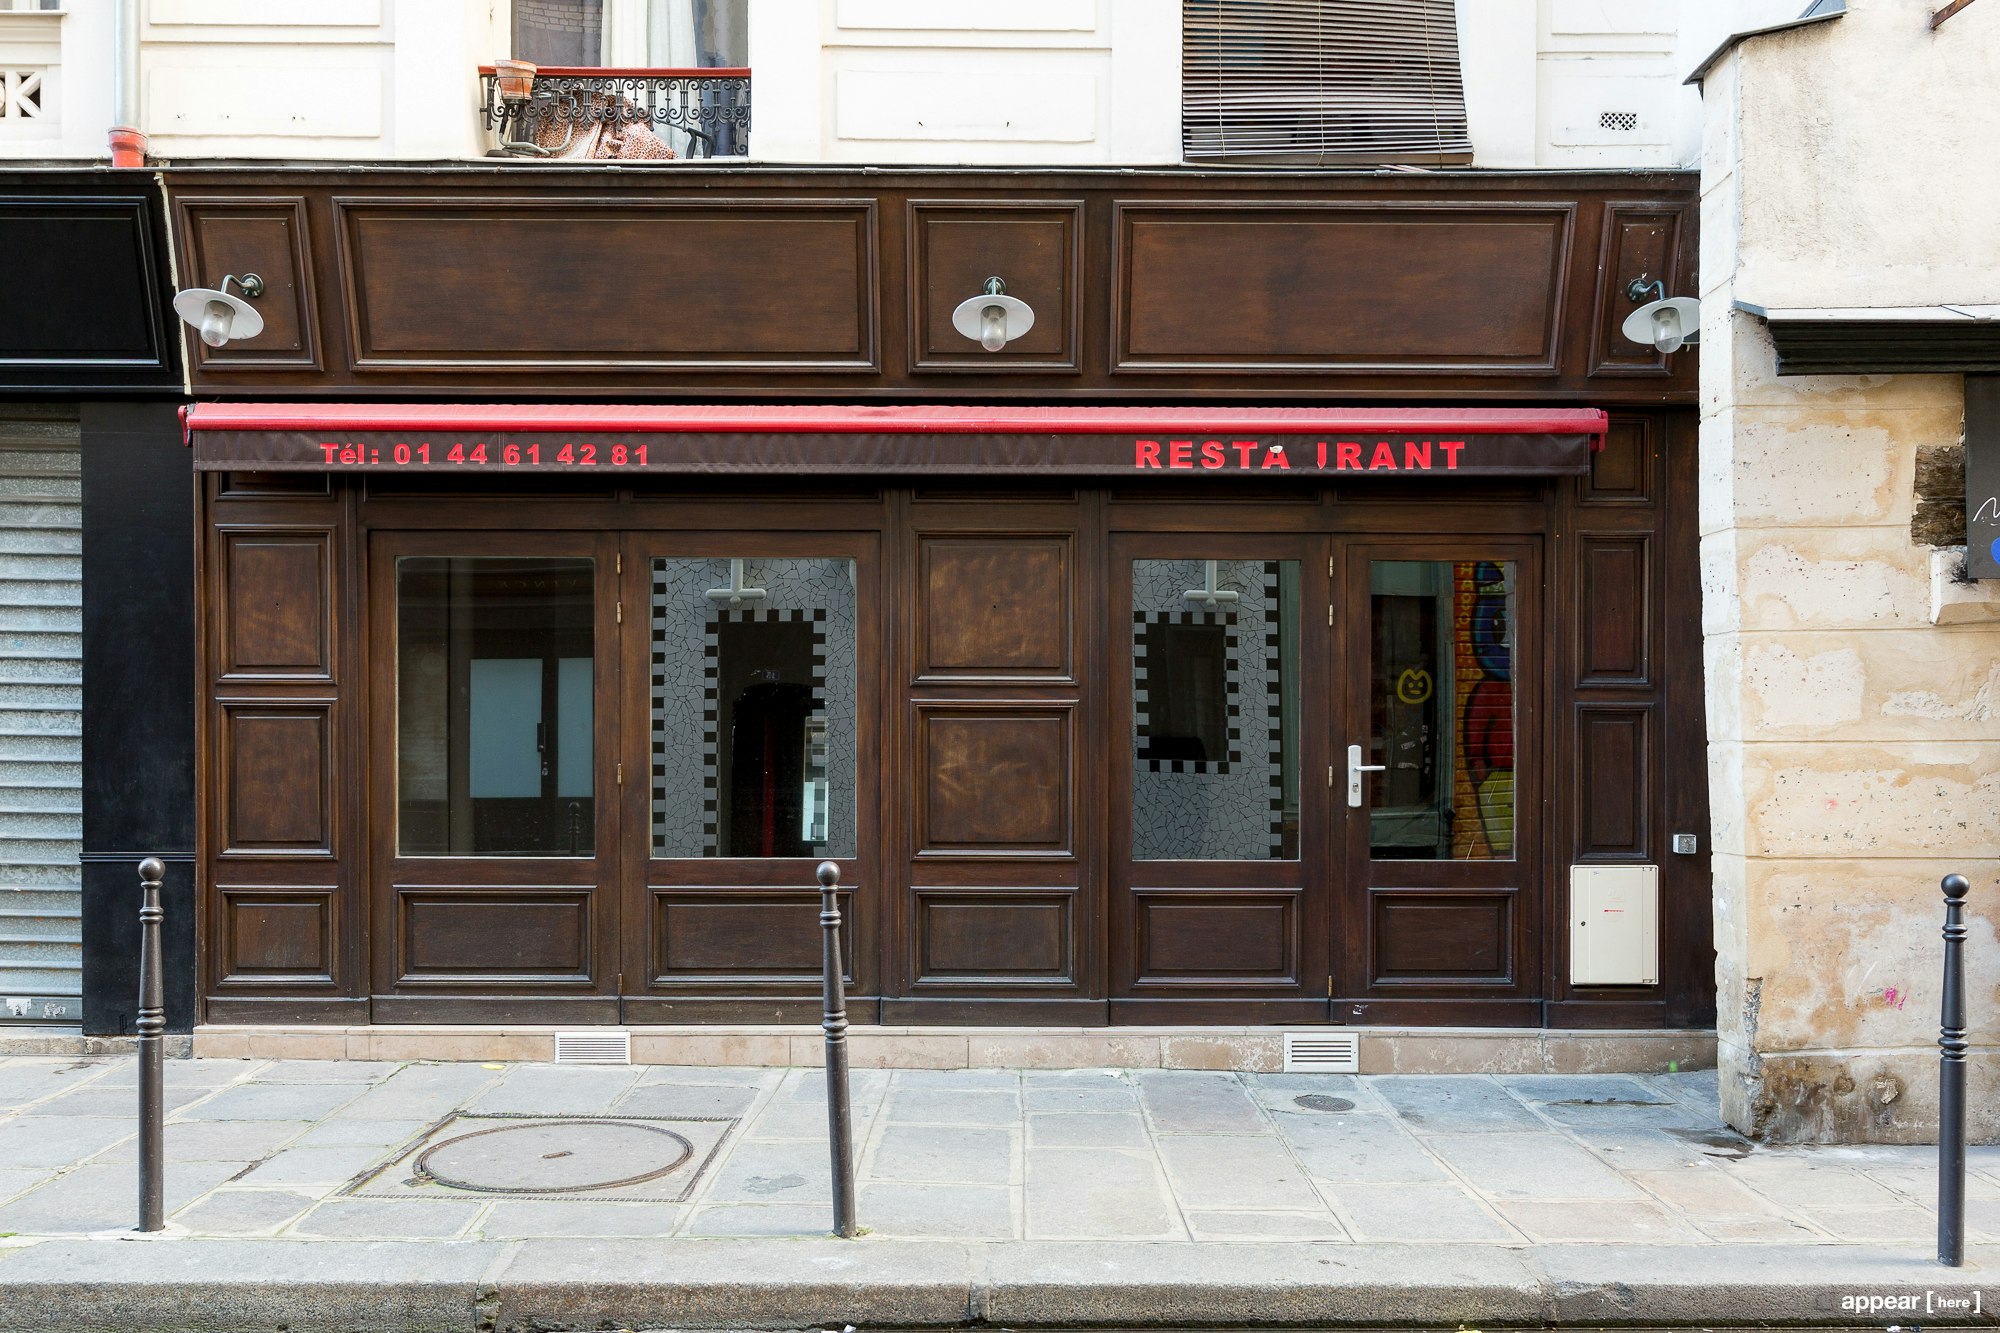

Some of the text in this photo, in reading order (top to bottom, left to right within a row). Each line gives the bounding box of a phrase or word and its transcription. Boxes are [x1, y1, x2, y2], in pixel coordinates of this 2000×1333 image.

[320, 443, 648, 466] Tél: 01 44 61 42 81
